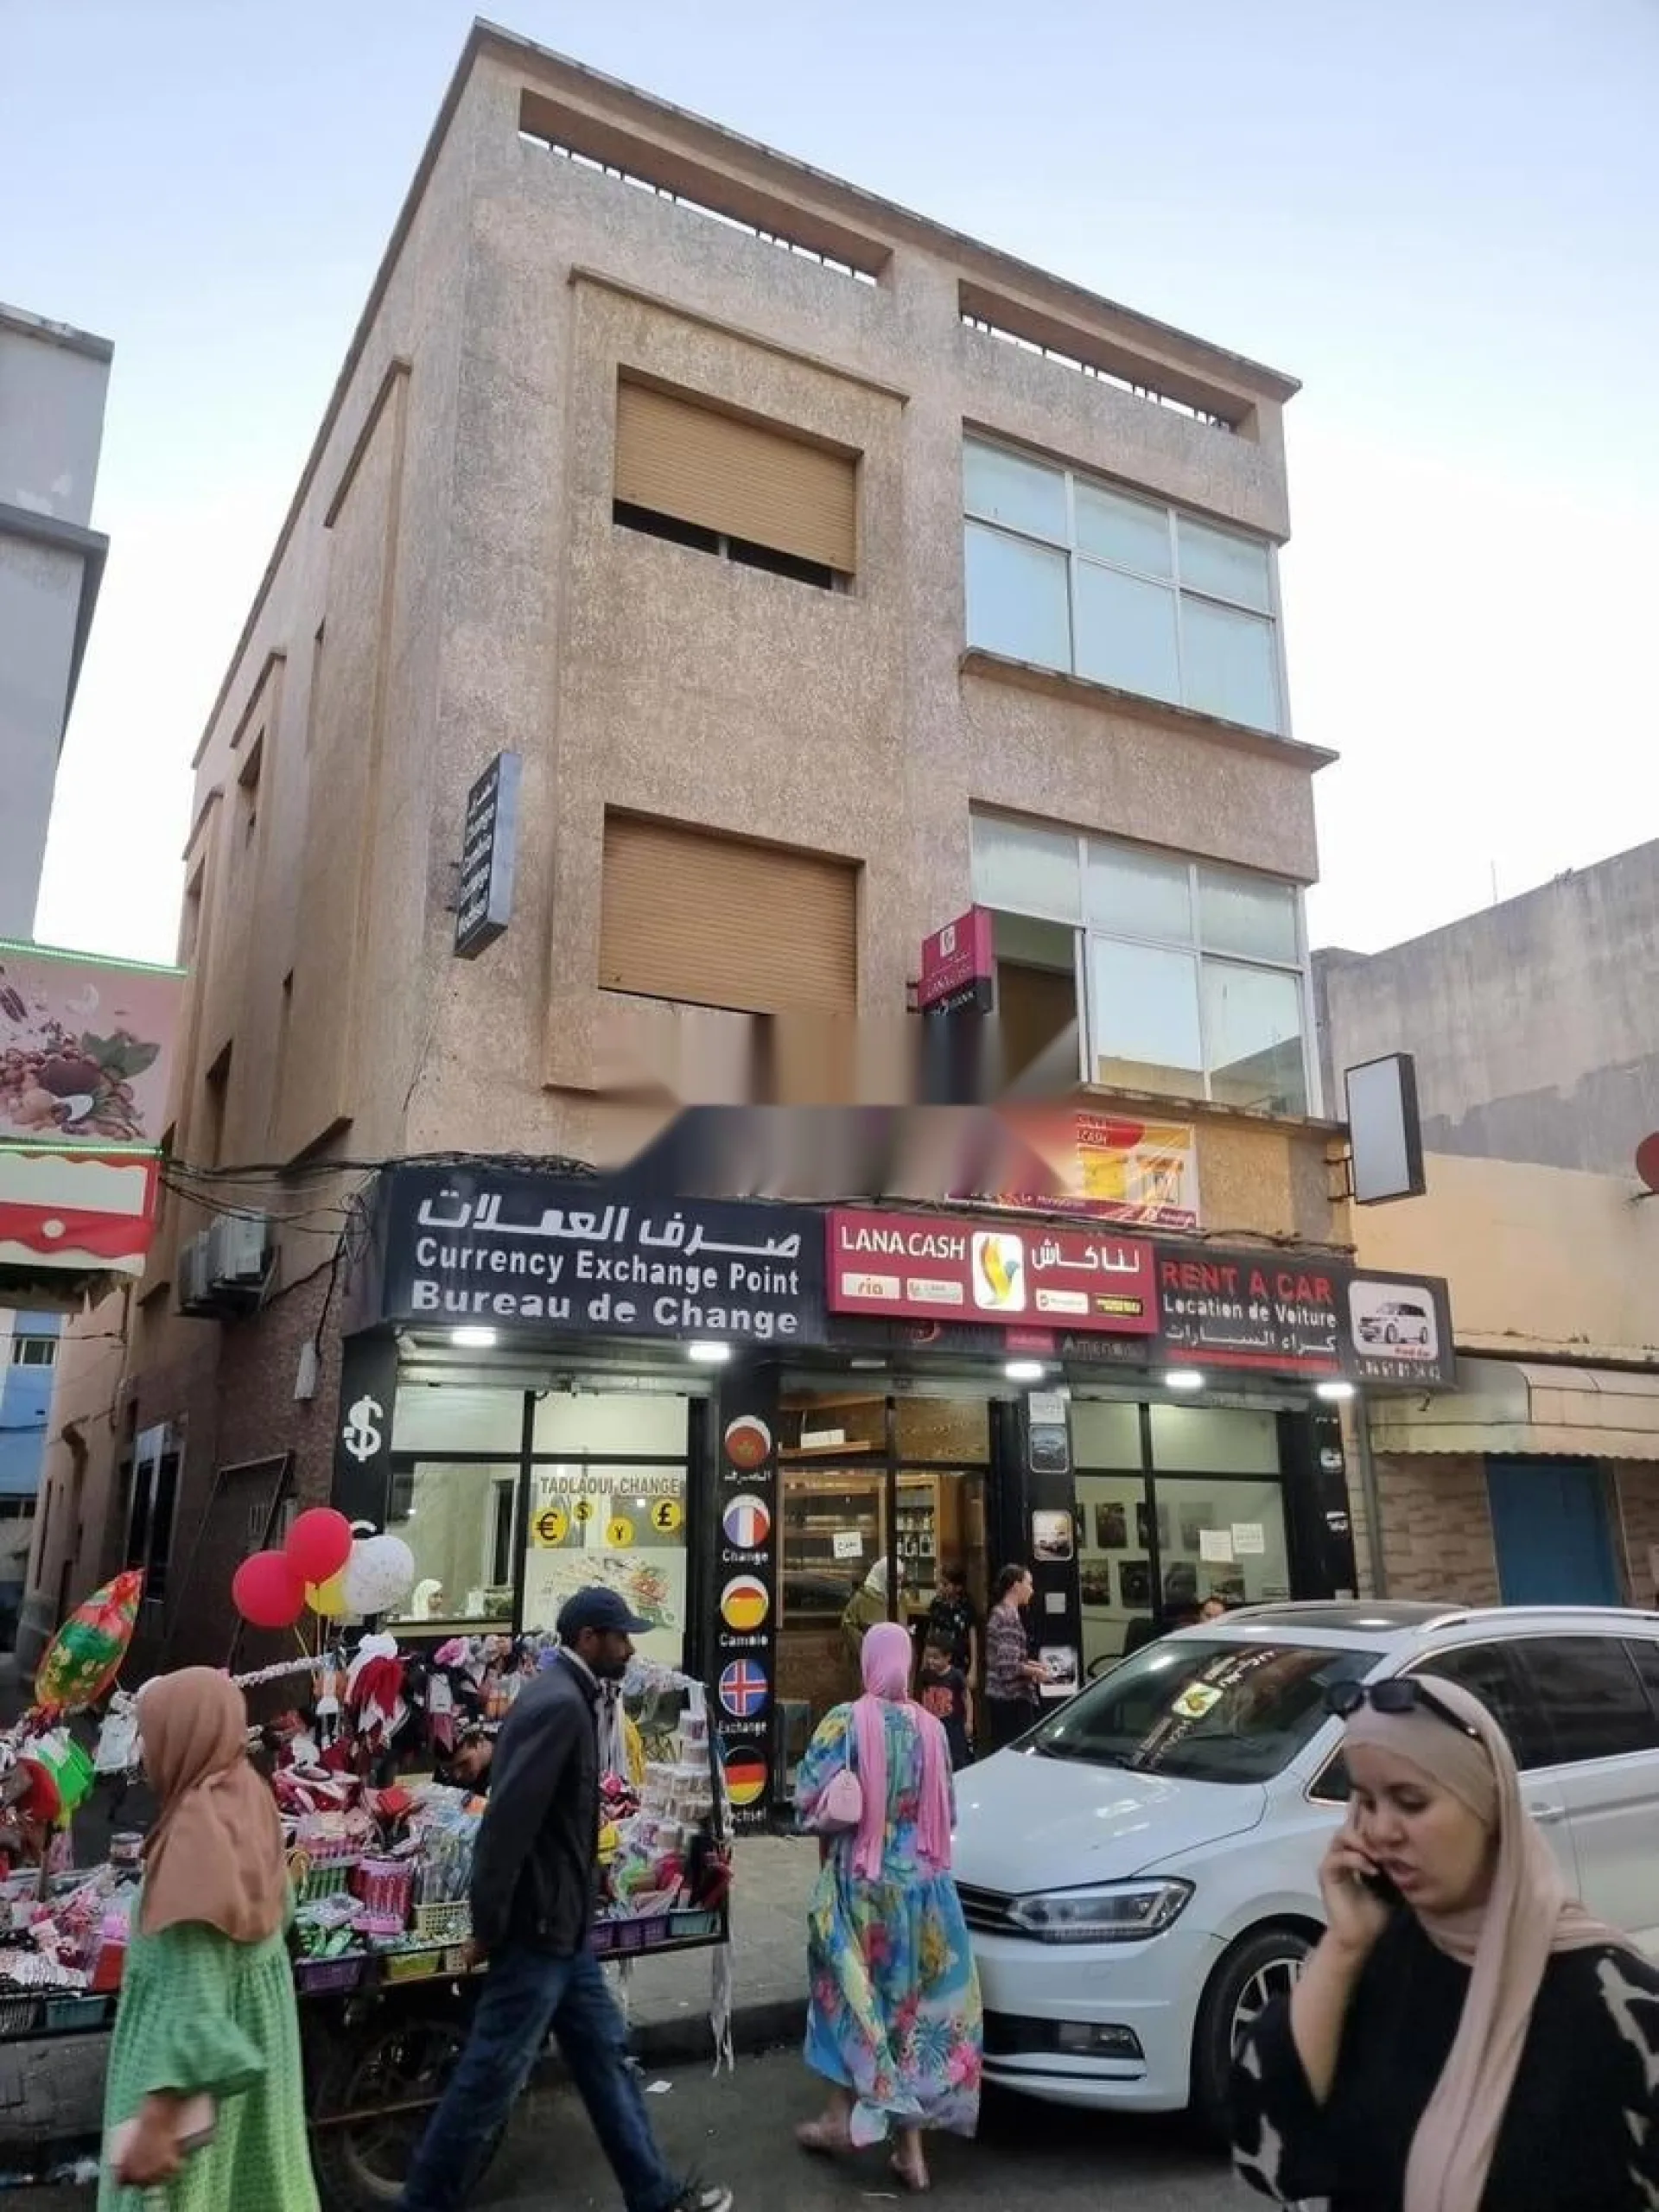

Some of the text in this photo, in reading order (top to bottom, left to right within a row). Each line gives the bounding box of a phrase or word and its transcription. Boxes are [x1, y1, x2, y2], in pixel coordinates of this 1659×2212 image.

[416, 1189, 802, 1257] صرف العملات
[841, 1226, 966, 1261] LANA CASH
[416, 1236, 800, 1295] Currency Exchange Point
[1161, 1261, 1333, 1305] RENT A CAR
[410, 1279, 799, 1339] Bureau de Change
[1162, 1293, 1243, 1320] Location
[1249, 1301, 1269, 1322] de
[1274, 1303, 1337, 1328] Voiture
[620, 1475, 681, 1495] CHANGE
[721, 1548, 770, 1566] Change
